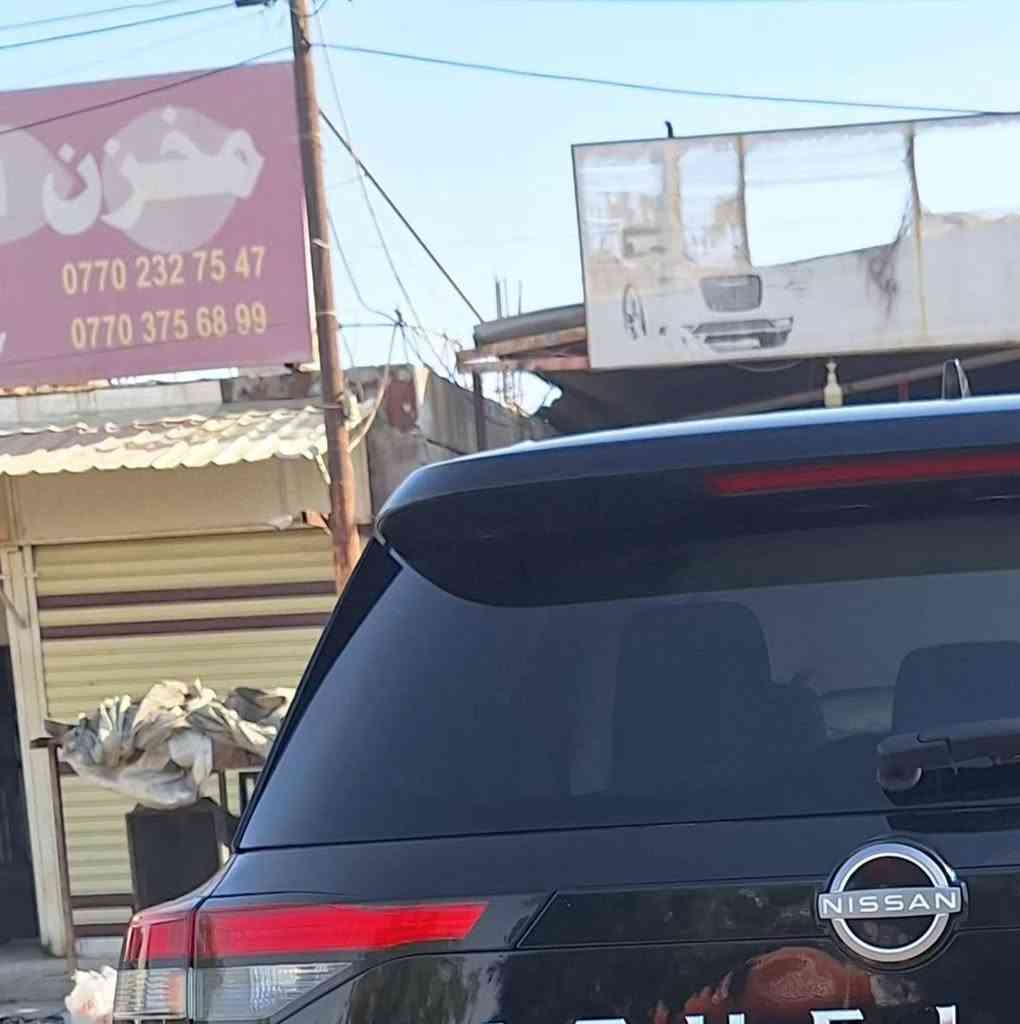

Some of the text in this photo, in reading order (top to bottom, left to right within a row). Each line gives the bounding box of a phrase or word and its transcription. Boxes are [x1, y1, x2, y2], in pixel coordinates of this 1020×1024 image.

[42, 106, 264, 235] مخزن
[62, 245, 265, 295] 0770 232 75 47
[71, 302, 267, 350] 0770 375 68 99
[822, 891, 957, 915] NISSAN
